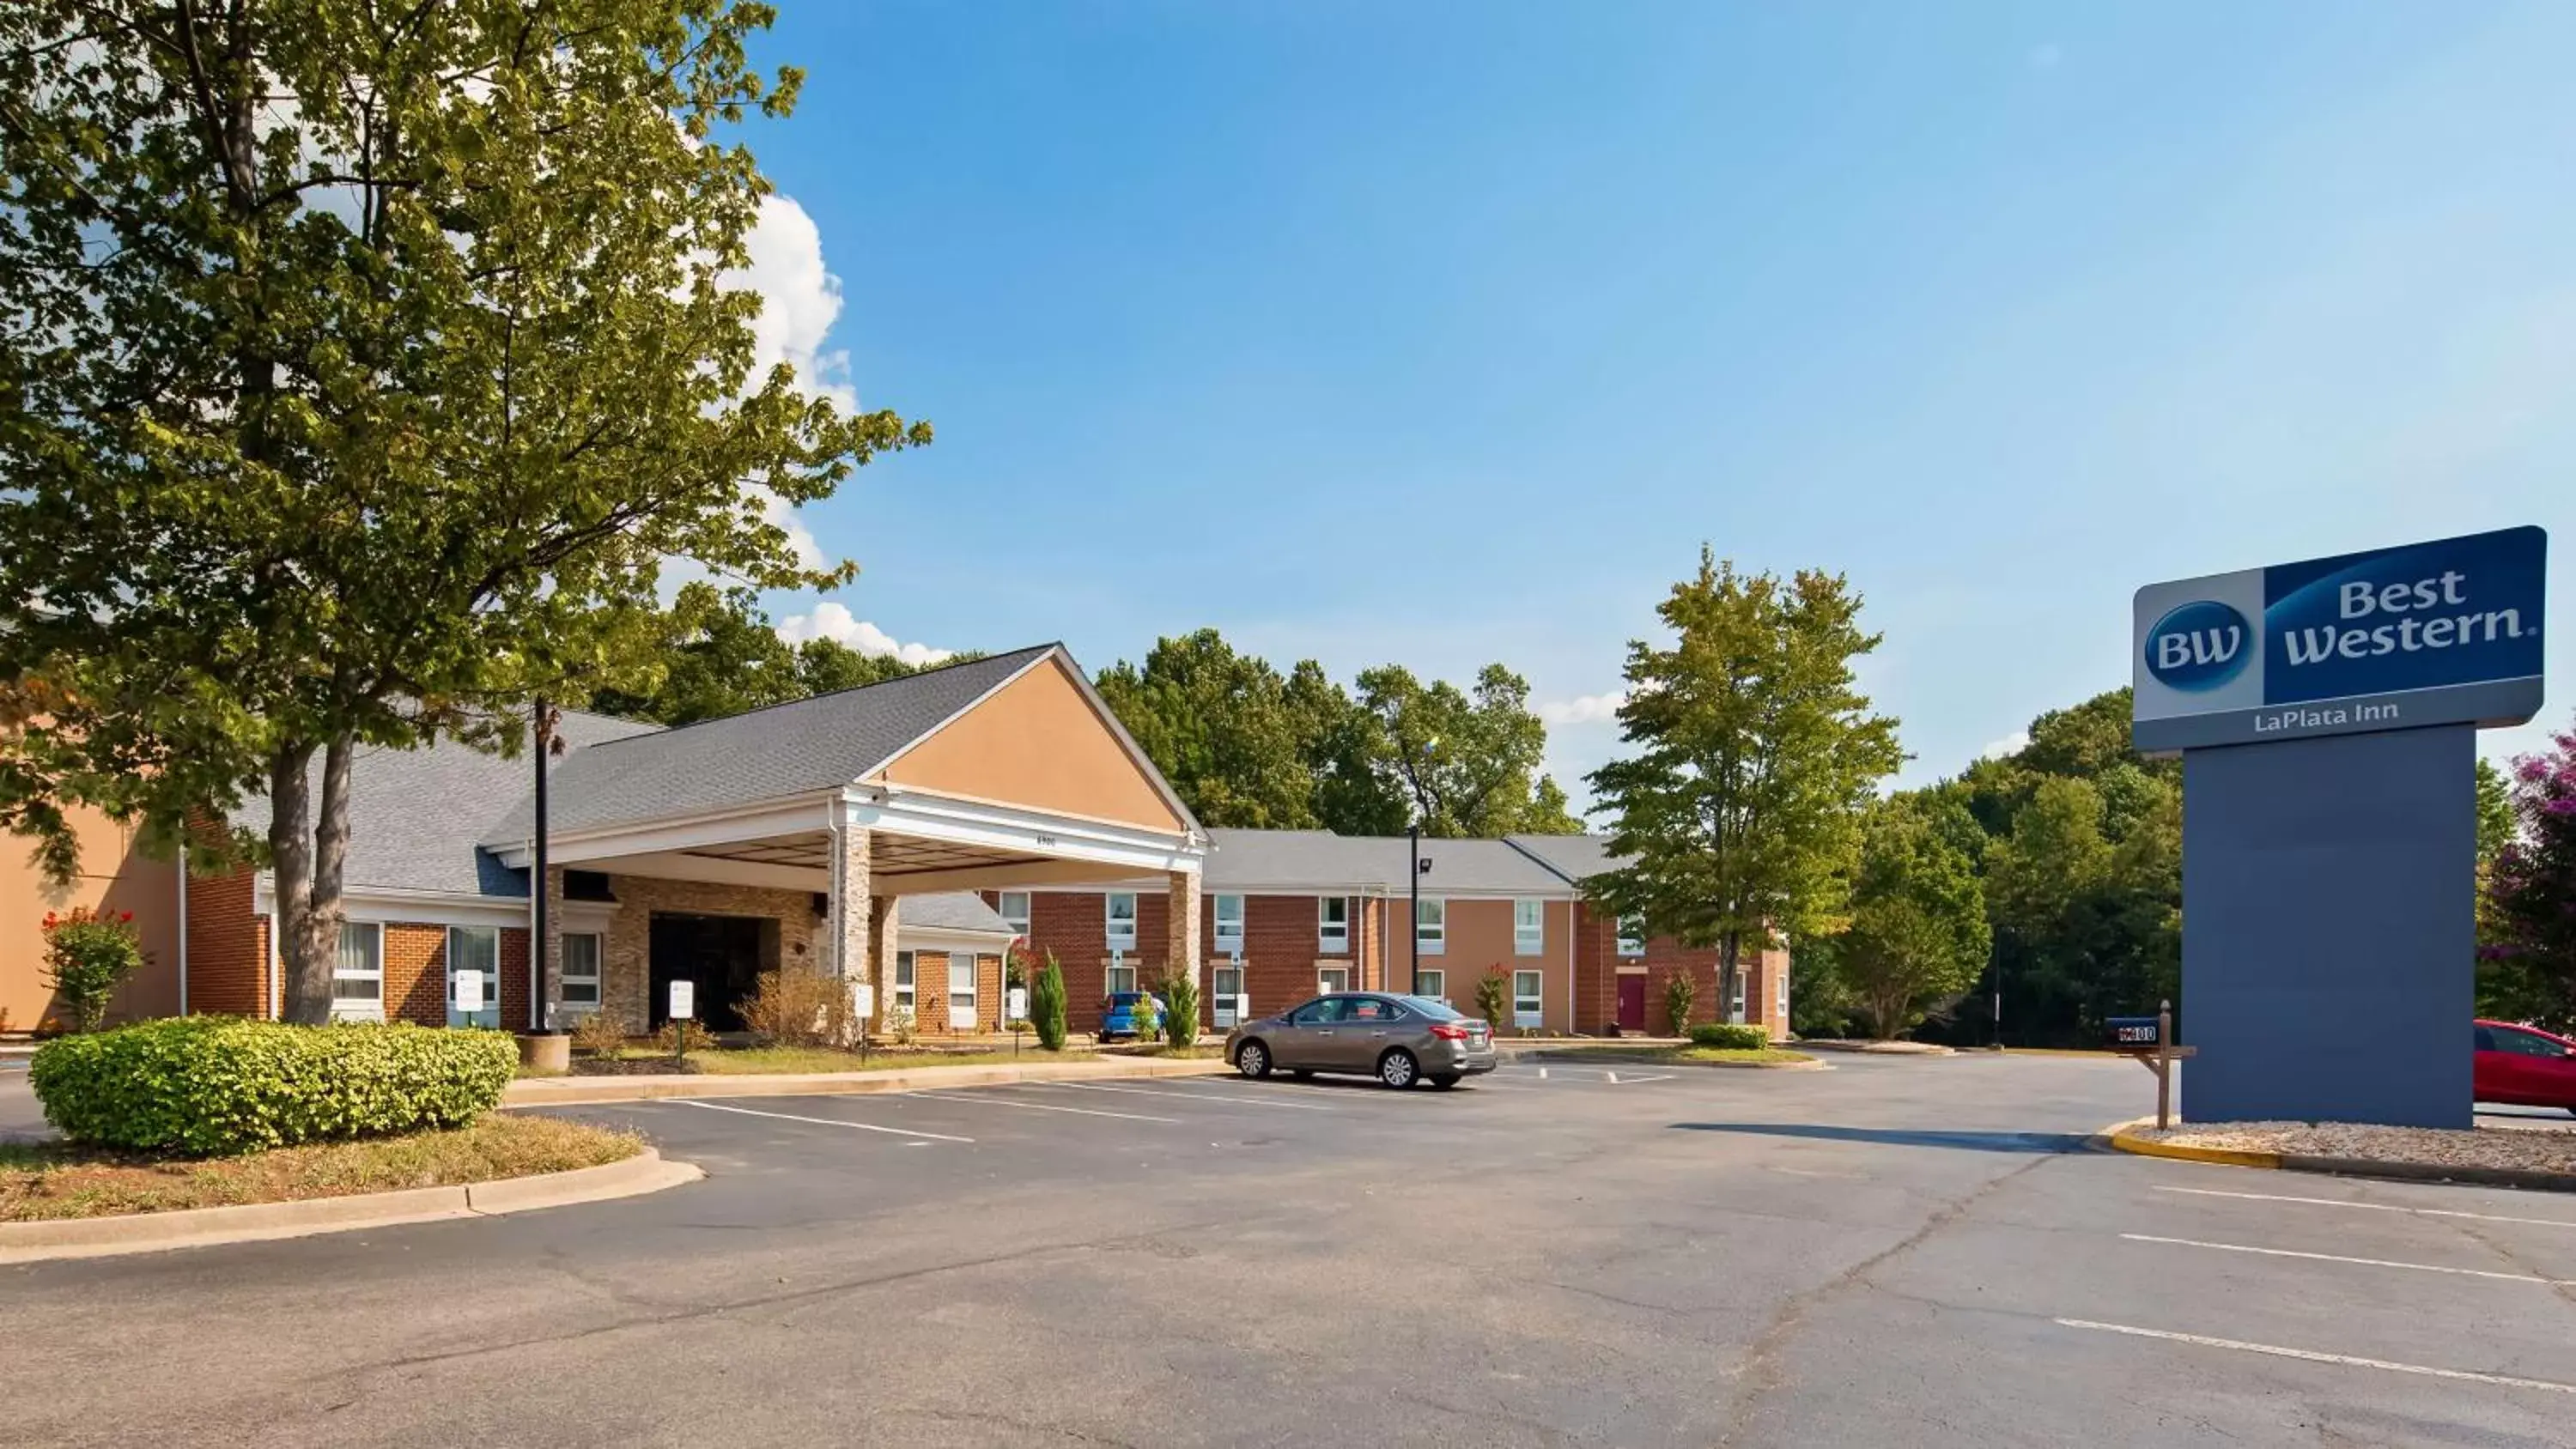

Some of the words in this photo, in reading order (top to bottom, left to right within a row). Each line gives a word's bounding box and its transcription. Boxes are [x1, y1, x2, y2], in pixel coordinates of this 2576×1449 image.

[2340, 570, 2467, 620] Best
[2158, 625, 2241, 670] BW
[2284, 608, 2524, 666] Western
[2254, 707, 2348, 732] LaPlata
[2354, 703, 2399, 723] Inn
